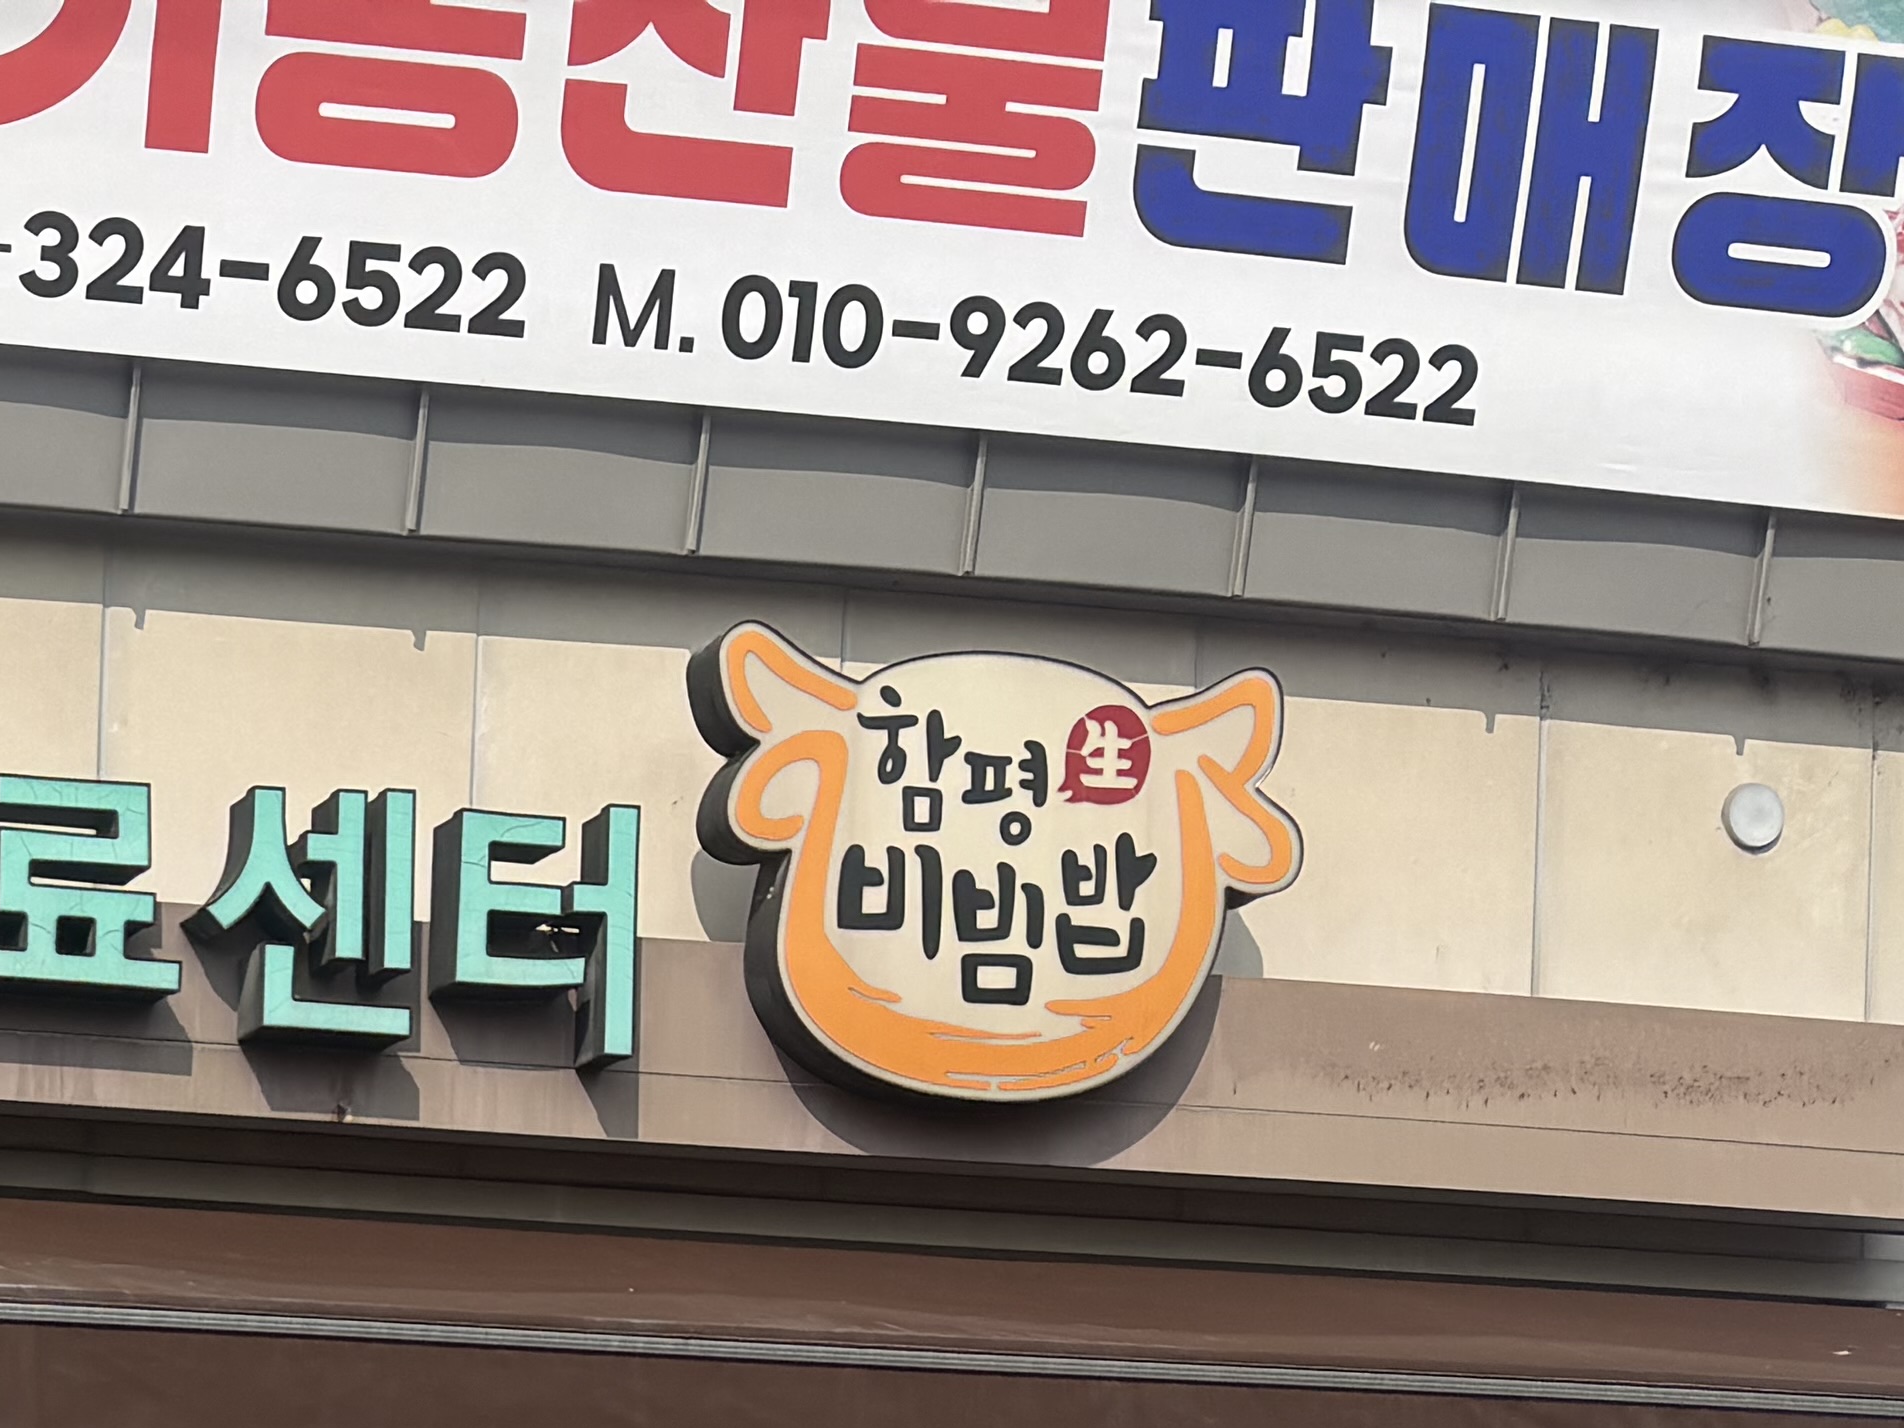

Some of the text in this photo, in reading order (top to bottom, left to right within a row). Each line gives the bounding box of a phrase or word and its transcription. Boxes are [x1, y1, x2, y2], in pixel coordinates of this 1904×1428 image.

[592, 264, 697, 355] M.
[720, 277, 1480, 427] 010-9262-6522
[836, 832, 1158, 1006] 비빔밥
